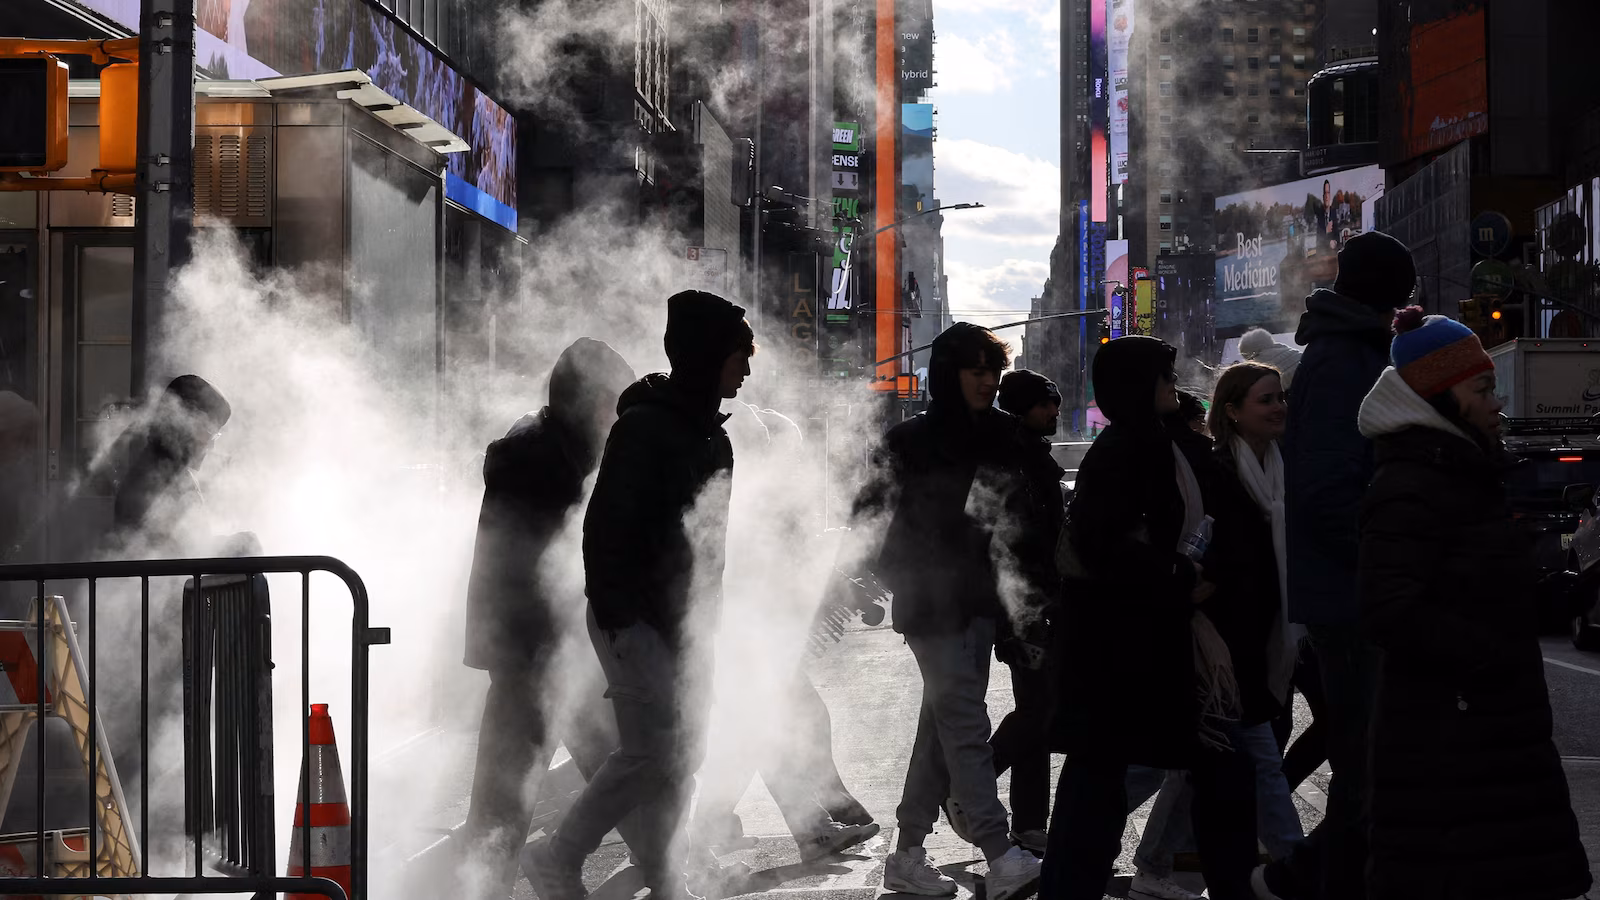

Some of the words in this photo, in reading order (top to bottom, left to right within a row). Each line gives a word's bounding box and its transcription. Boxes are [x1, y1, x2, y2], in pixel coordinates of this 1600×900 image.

[690, 249, 697, 260] 3
[1236, 231, 1263, 260] Best
[1223, 259, 1277, 293] Medicine
[1536, 402, 1581, 414] Summit
[1584, 403, 1600, 414] Pa
